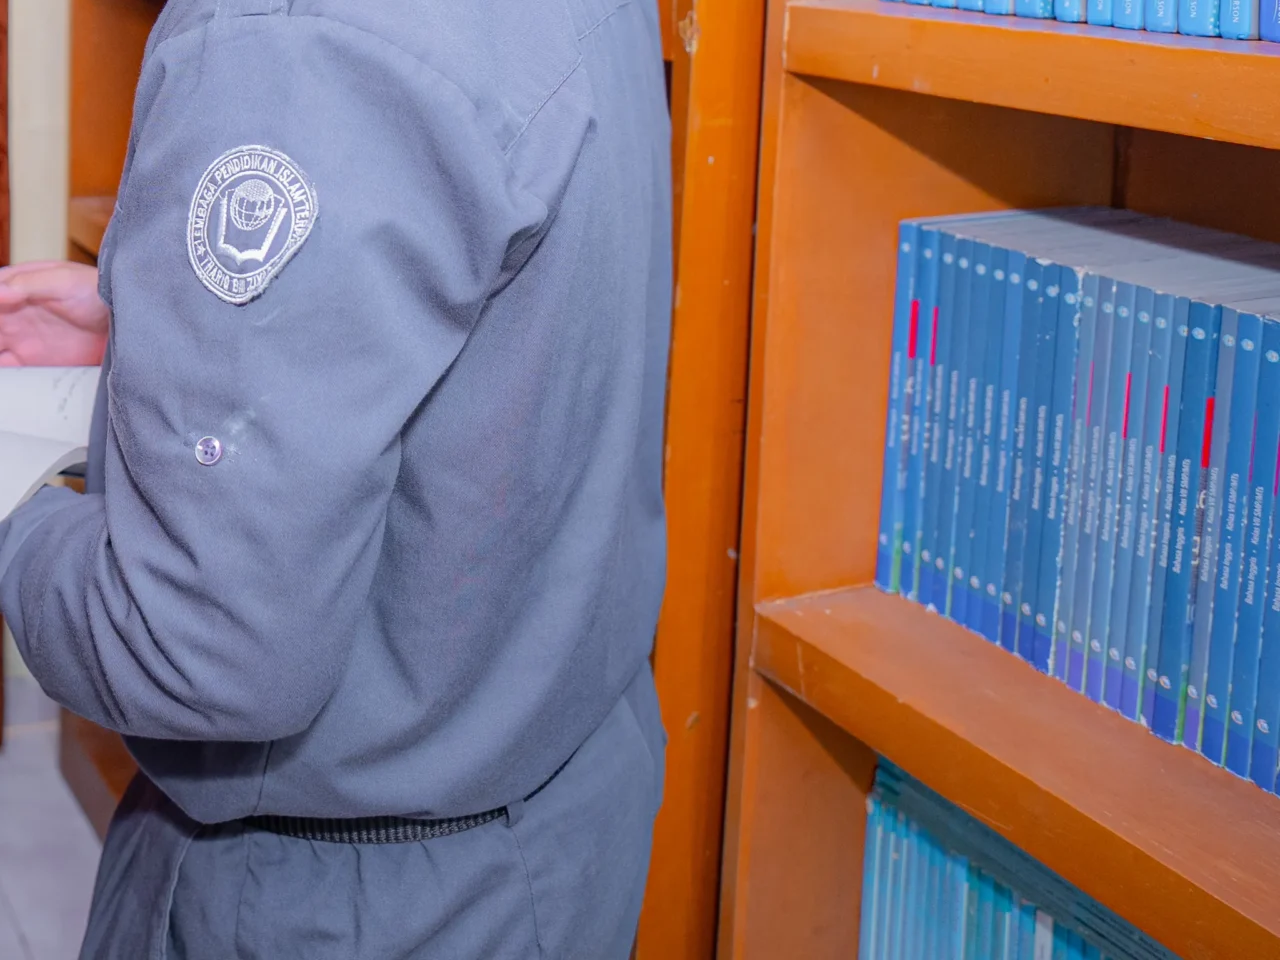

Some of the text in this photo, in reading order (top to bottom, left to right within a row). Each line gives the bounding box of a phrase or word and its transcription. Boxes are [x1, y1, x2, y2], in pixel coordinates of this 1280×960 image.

[193, 181, 218, 245] LEMBAGA
[215, 154, 278, 185] PENDIDIKAN
[274, 167, 308, 204] ISLAM
[200, 256, 231, 291] THARIQ
[232, 277, 246, 293] BIN
[1172, 550, 1182, 574] Bahasa
[1220, 565, 1230, 590] Bahasa
[1244, 580, 1254, 605] Bahasa
